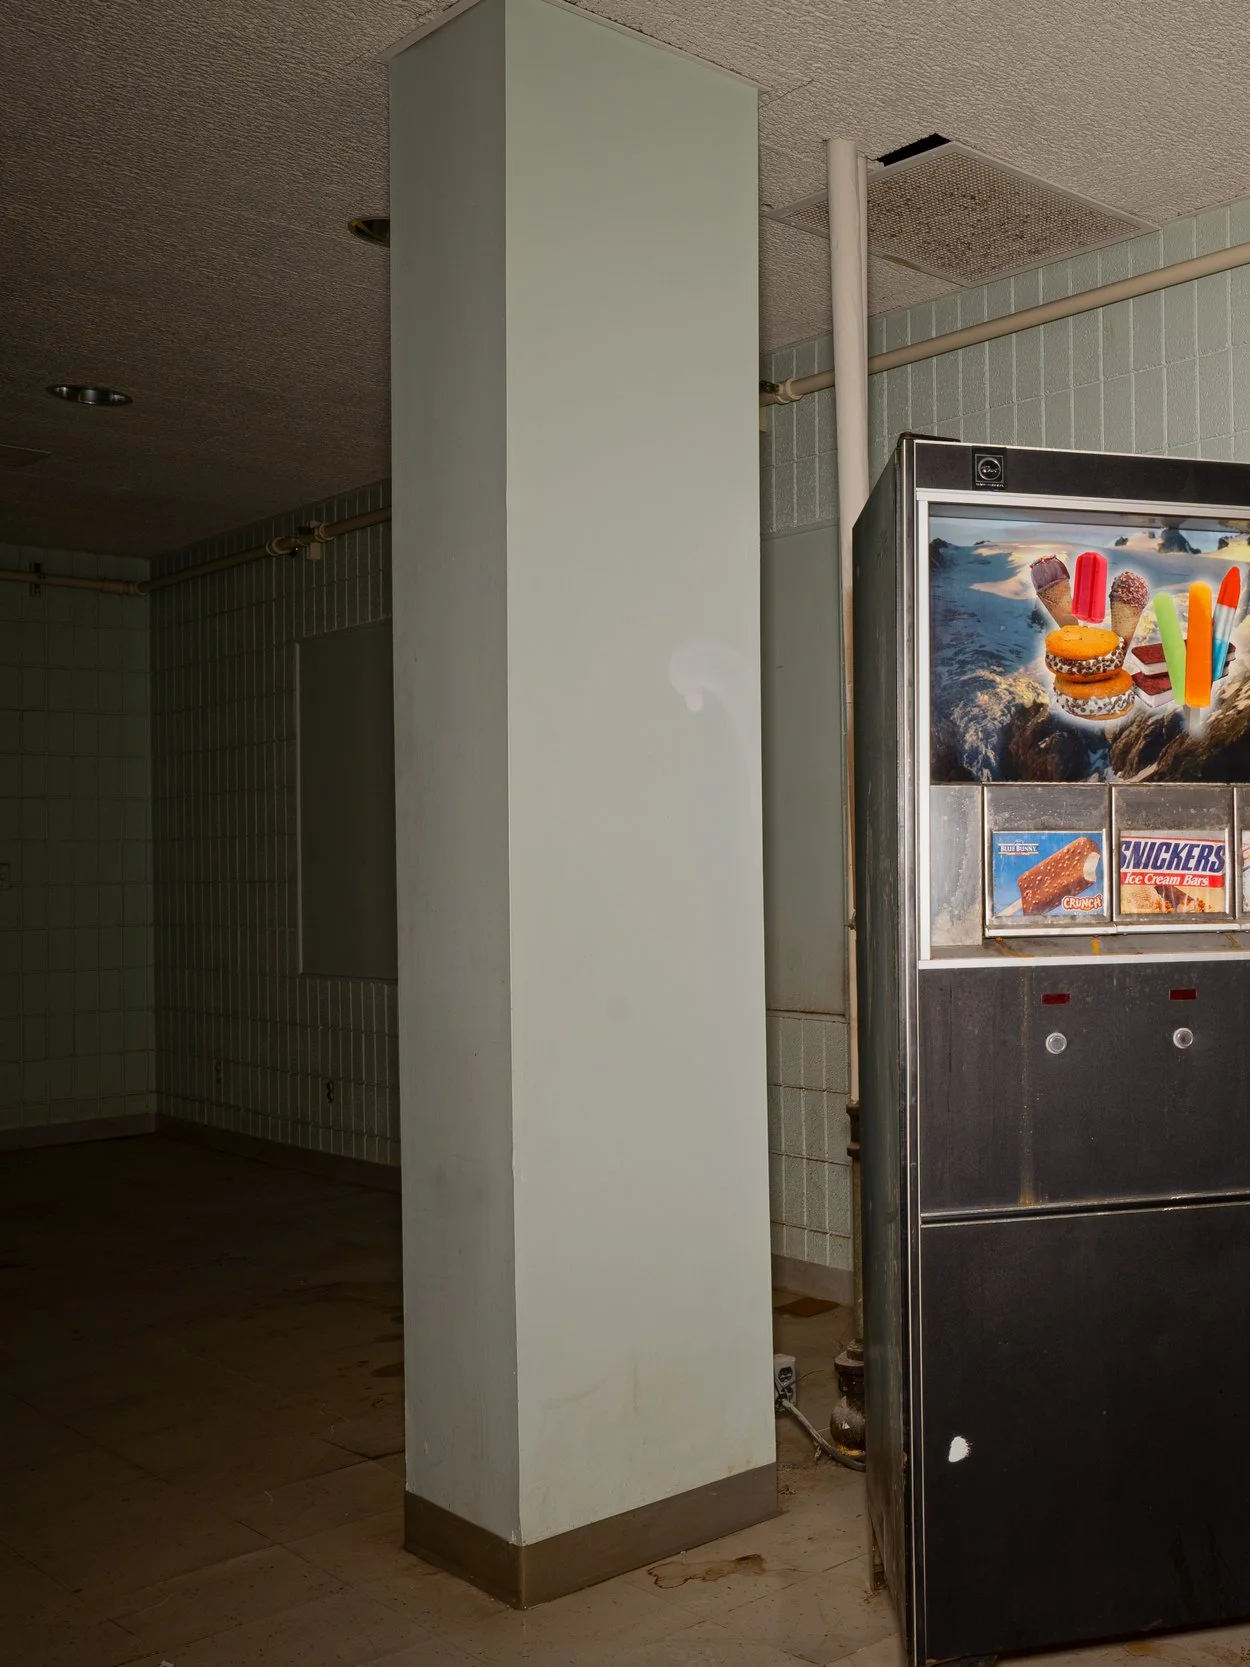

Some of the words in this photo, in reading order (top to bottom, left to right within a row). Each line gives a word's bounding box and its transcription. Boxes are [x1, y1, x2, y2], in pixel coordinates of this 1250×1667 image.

[1120, 840, 1226, 873] SNICKERS
[1124, 872, 1144, 884] Ice
[1144, 874, 1180, 885] Cream
[1183, 875, 1208, 886] Bars
[1063, 894, 1102, 910] CRUNCH
